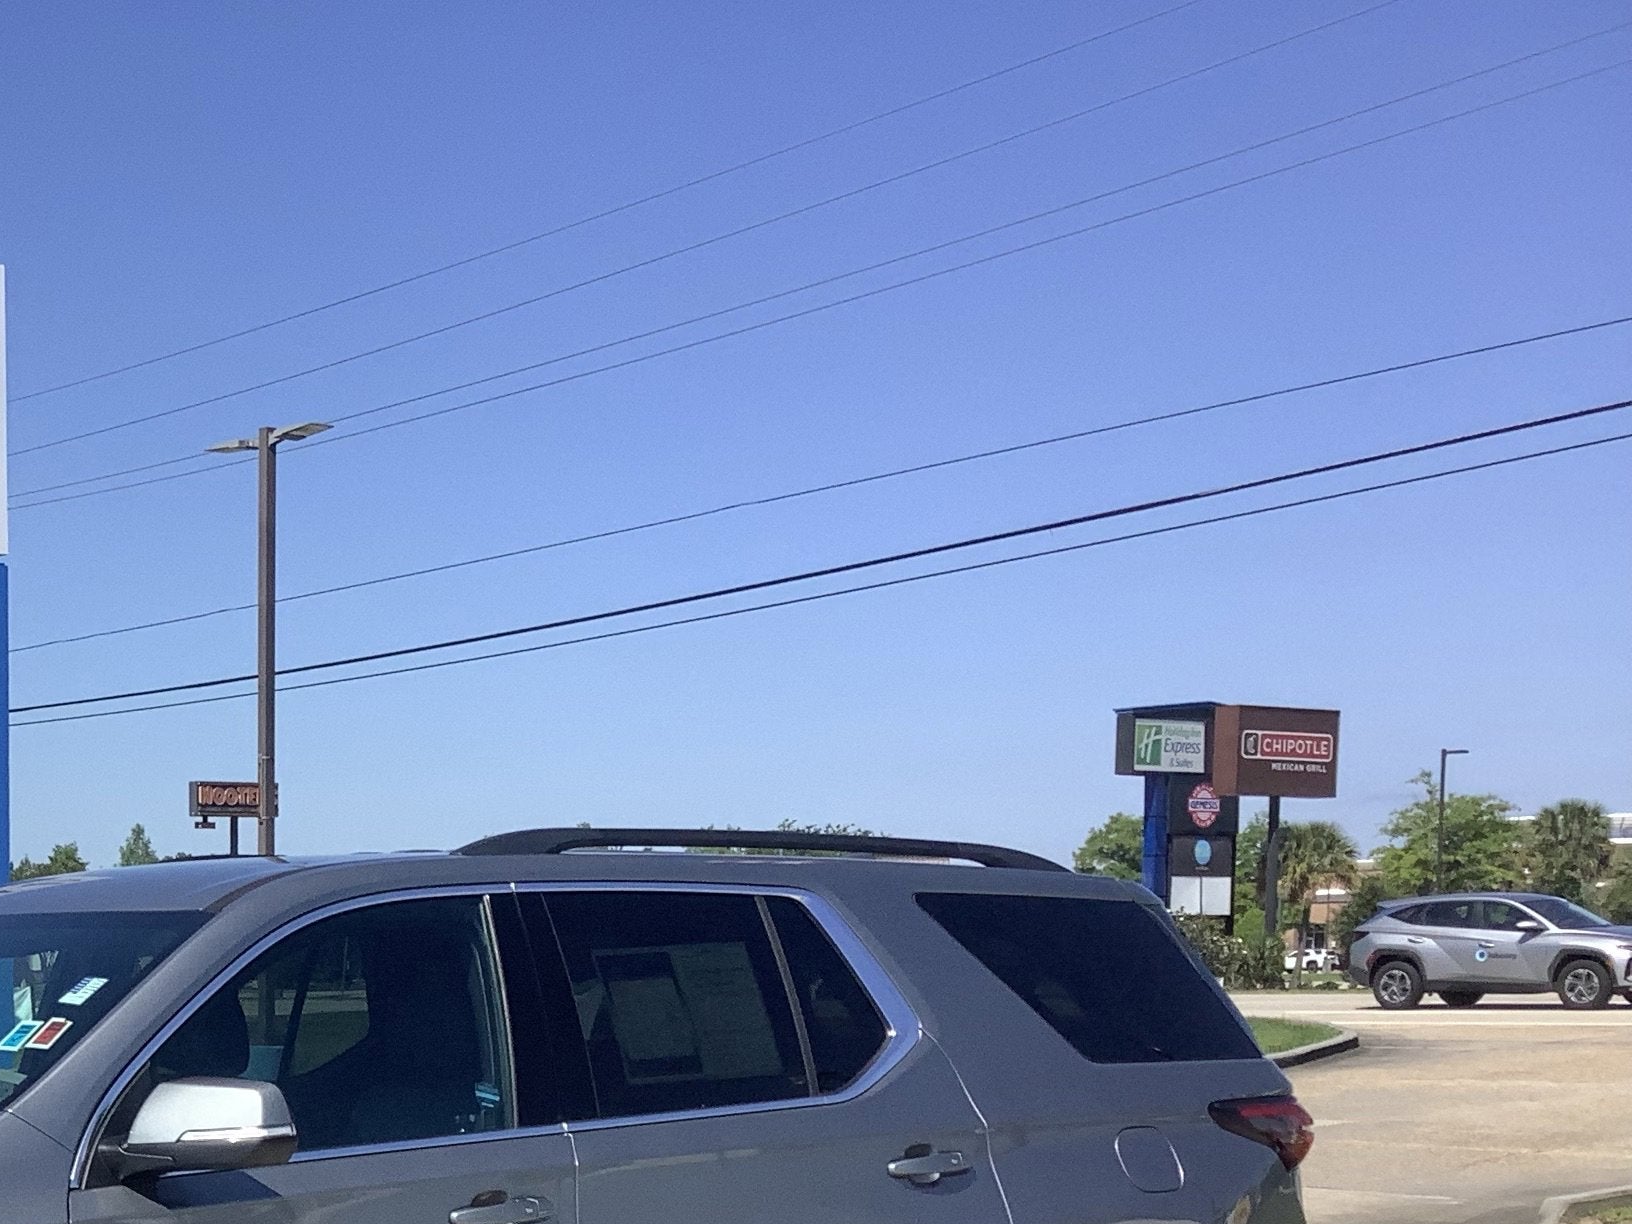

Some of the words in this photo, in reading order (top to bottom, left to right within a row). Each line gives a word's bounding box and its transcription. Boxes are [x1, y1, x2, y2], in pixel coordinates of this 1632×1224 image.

[1164, 737, 1202, 756] Express
[1262, 738, 1329, 755] CHIPOTLE
[1271, 762, 1305, 772] MEXICAN
[1306, 763, 1327, 773] GRILL
